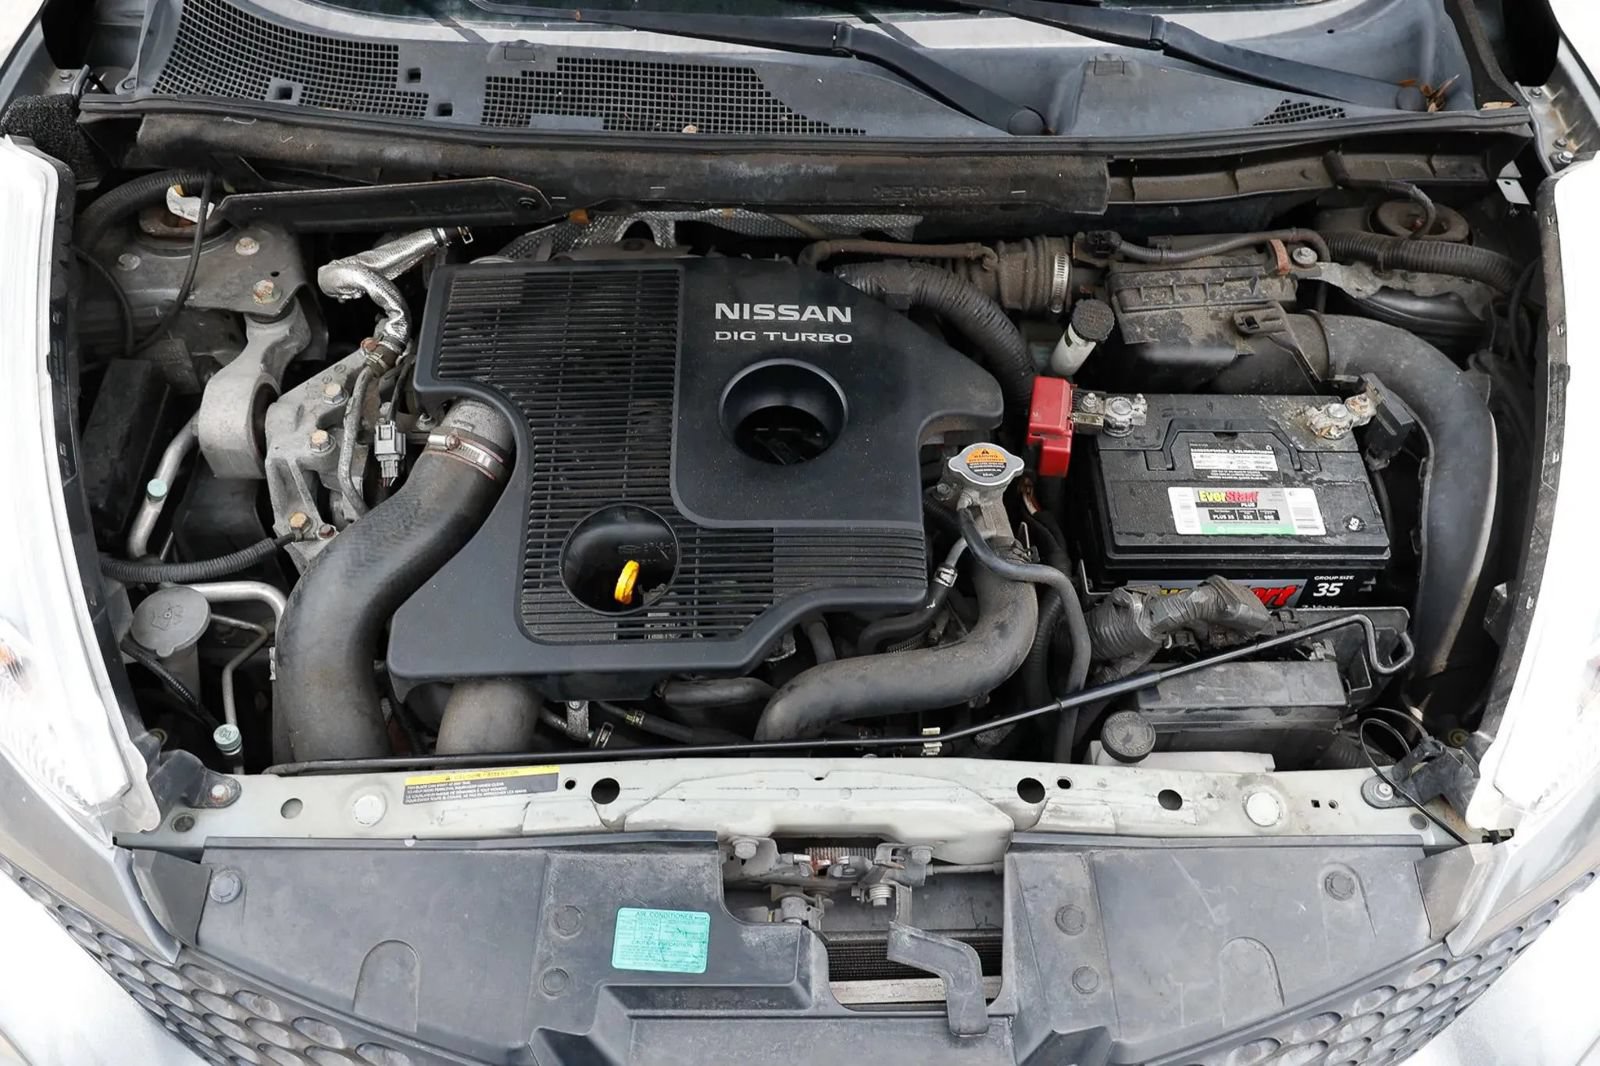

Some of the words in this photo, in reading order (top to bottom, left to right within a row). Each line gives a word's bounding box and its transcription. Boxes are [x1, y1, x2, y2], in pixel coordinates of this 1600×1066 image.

[715, 303, 852, 323] NISSAN
[715, 331, 756, 341] DIG
[763, 331, 853, 343] TURBO
[1198, 490, 1259, 503] EverStart
[1312, 582, 1344, 597] 35
